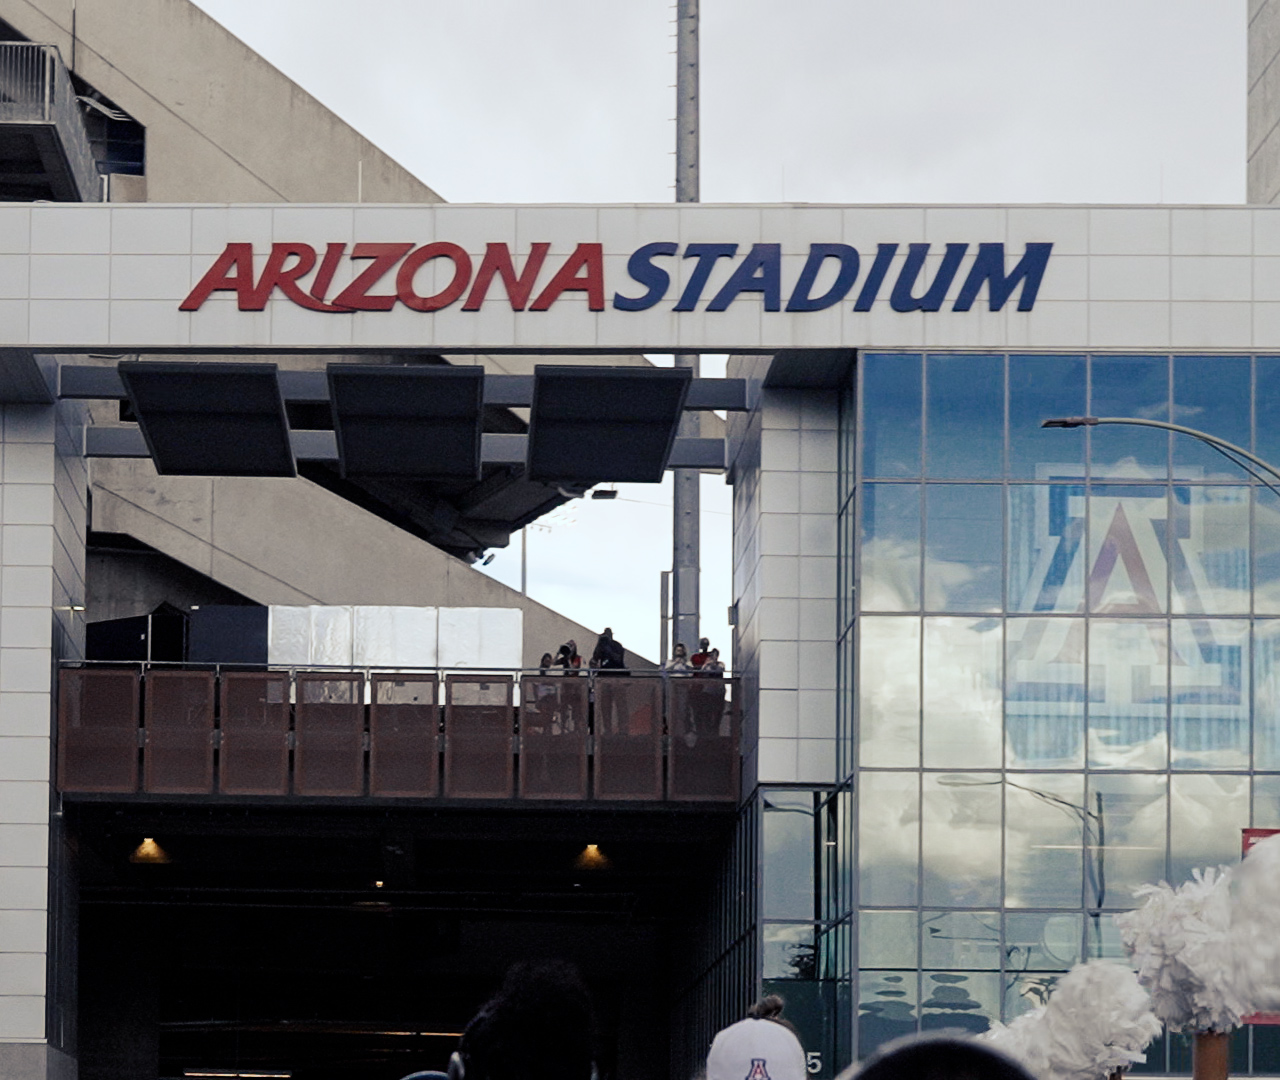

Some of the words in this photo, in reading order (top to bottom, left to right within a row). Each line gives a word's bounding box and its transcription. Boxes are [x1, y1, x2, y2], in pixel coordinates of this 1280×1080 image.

[179, 242, 605, 313] ARIZONA
[613, 242, 1053, 312] STADIUM
[995, 463, 1251, 717] A
